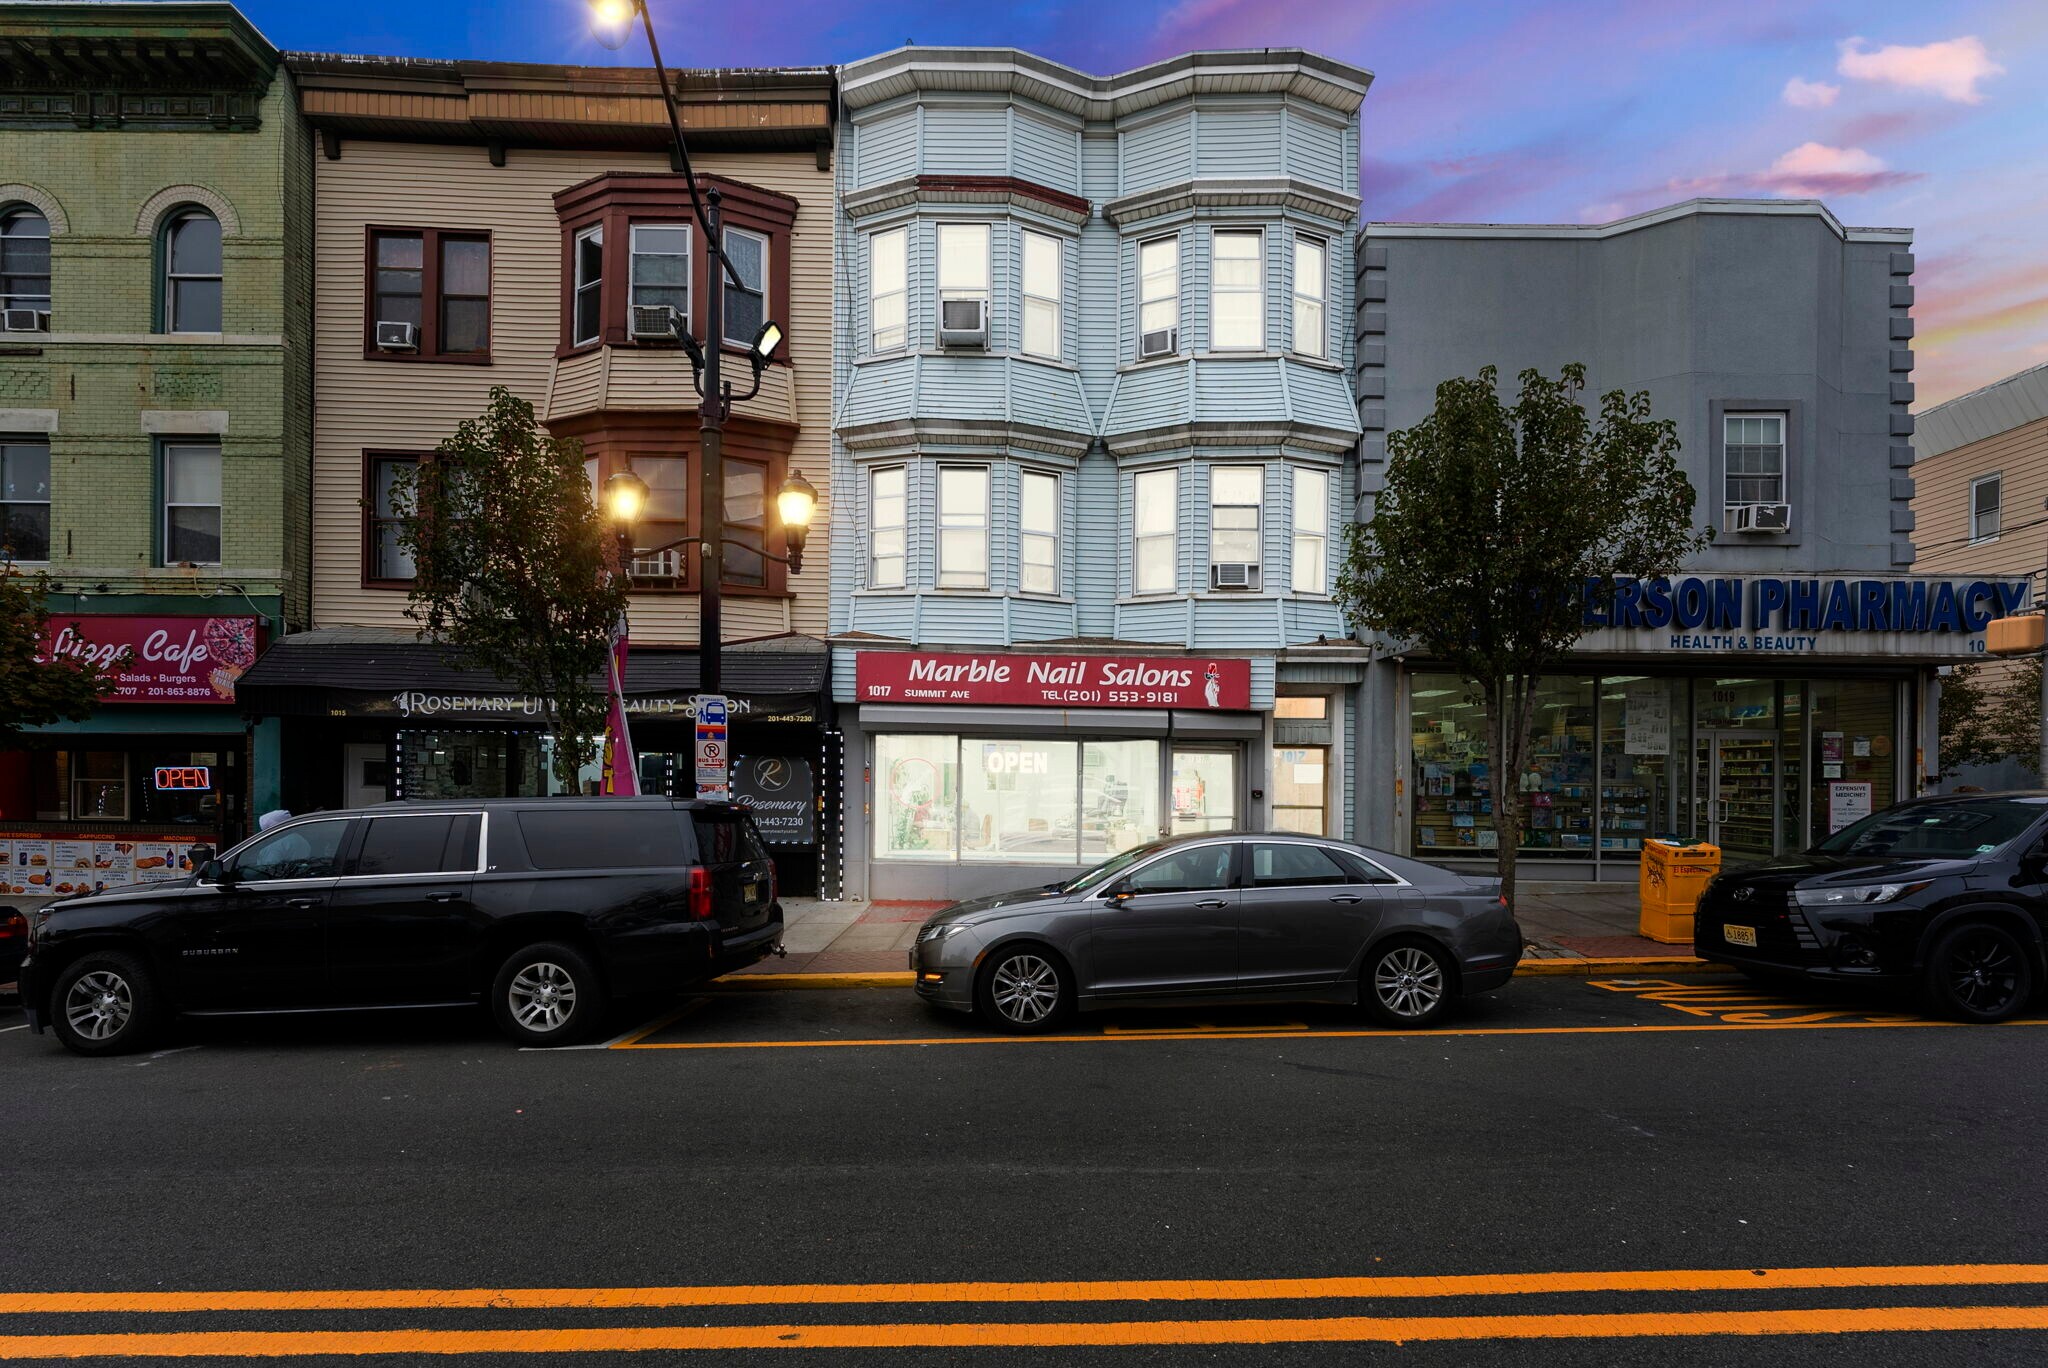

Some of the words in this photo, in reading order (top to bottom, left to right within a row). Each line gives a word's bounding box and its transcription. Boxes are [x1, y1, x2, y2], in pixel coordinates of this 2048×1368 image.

[1581, 576, 1742, 630] ERSON
[1753, 579, 2029, 633] PHARMACY
[1671, 635, 1732, 649] HEALTH
[1738, 636, 1748, 650] &
[1754, 636, 1817, 651] BEAUTY
[1969, 640, 1984, 652] 10
[143, 628, 208, 674] Cafe
[119, 673, 151, 683] Salads
[159, 673, 197, 685] Burgers
[908, 658, 1010, 683] Marble
[1026, 660, 1087, 685] Nail
[1099, 662, 1193, 687] Salons
[147, 687, 211, 697] 201-863-8876
[868, 685, 891, 697] 1017
[904, 689, 947, 698] SUMMIT
[950, 690, 970, 699] AVE
[1108, 691, 1178, 703] 553-9181
[1712, 691, 1735, 702] 1019
[330, 709, 346, 717] 1015
[409, 694, 515, 714] ROSEMARY
[622, 698, 675, 713] EAUTY
[686, 695, 750, 718] SON
[767, 715, 812, 723] 201-443-7230
[988, 751, 1048, 774] OPEN
[157, 768, 208, 788] OPEN
